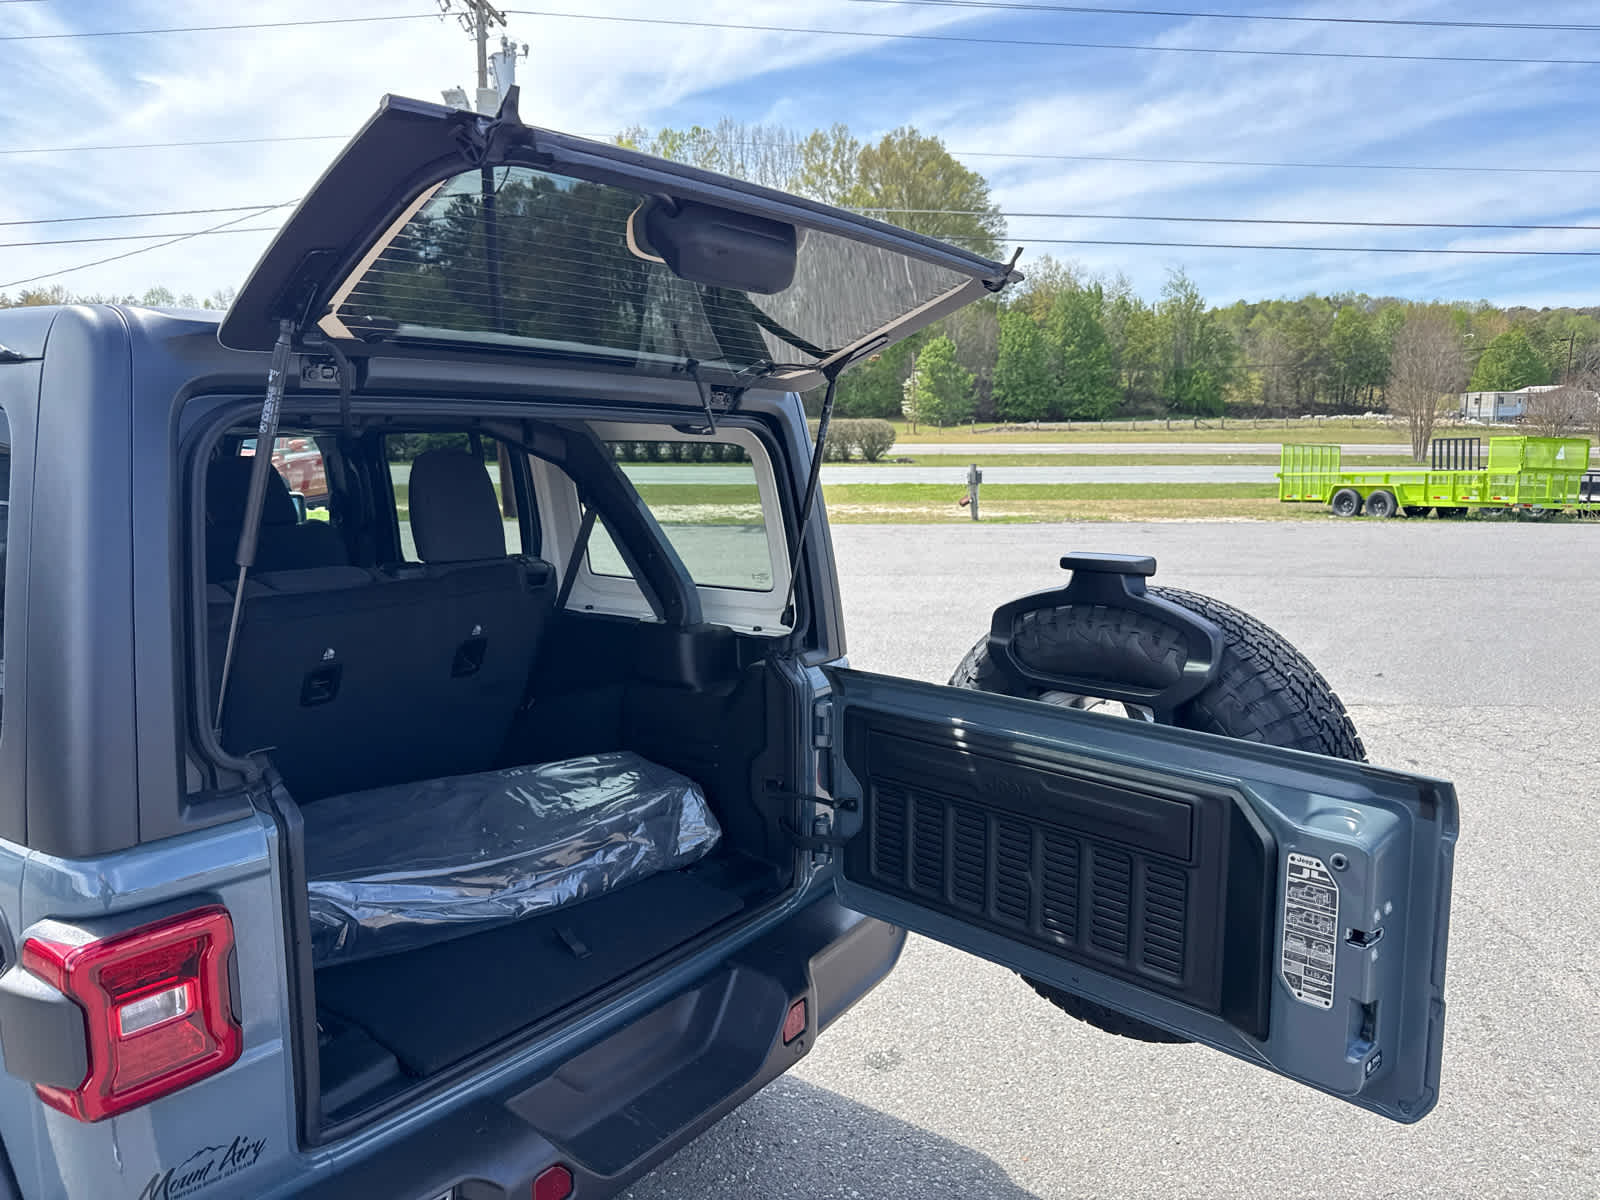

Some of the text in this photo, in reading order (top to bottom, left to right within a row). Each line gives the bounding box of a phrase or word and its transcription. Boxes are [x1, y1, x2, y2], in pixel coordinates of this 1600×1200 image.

[1296, 856, 1314, 866] Jeep
[138, 1136, 267, 1200] Mount Airy
